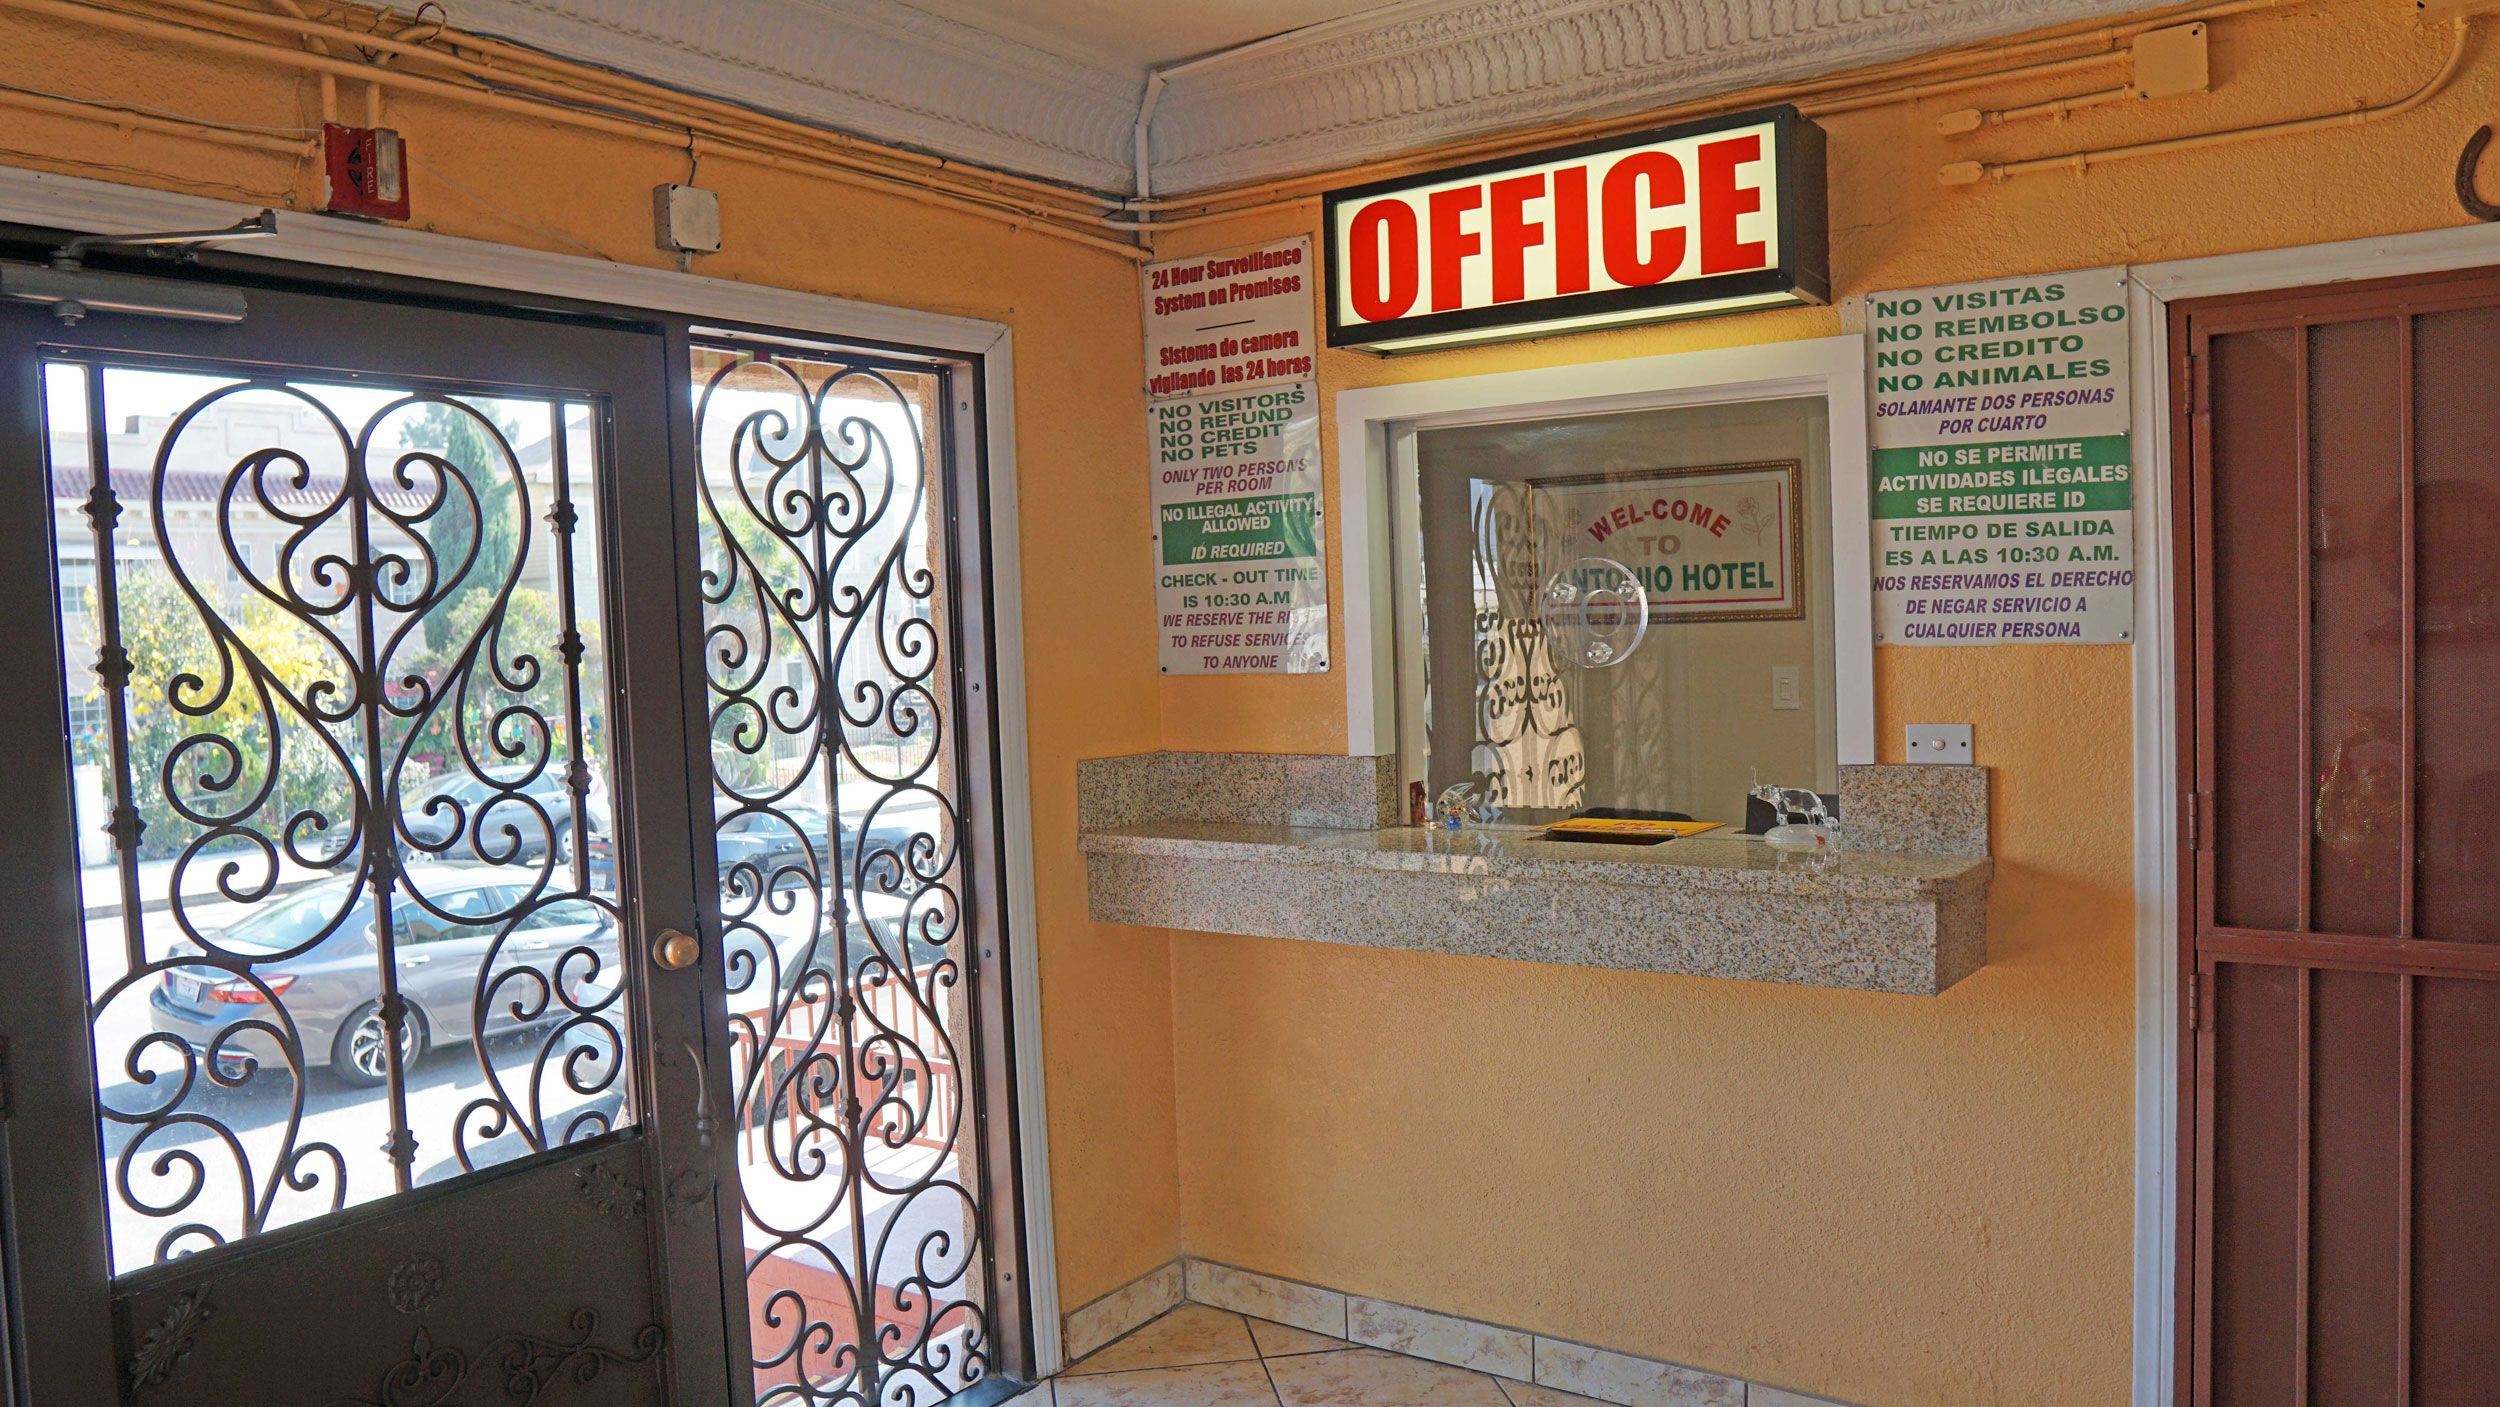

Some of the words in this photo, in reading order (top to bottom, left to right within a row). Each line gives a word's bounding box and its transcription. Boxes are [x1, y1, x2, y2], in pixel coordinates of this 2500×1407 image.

[365, 138, 375, 194] FIRE
[1348, 133, 1766, 323] OFFICE
[1152, 270, 1168, 290] 24
[1171, 265, 1205, 286] Hour
[1207, 247, 1302, 280] Surveillance
[1154, 291, 1206, 316] System
[1208, 287, 1227, 306] on
[1877, 299, 1922, 318] NO
[1932, 284, 2065, 312] VISITAS
[1877, 324, 1922, 343] NO
[1935, 304, 2125, 338] REMBOLSO
[1160, 341, 1217, 366] Sistema
[1220, 337, 1238, 357] de
[1241, 330, 1299, 354] camera
[1877, 349, 1922, 368] NO
[1935, 335, 2084, 363] CREDITO
[1150, 367, 1216, 394] vigilando
[1221, 364, 1243, 384] las
[1246, 359, 1264, 380] 24
[1267, 355, 1312, 376] horas
[1878, 374, 1923, 393] NO
[1933, 359, 2111, 389] ANIMALES
[1159, 404, 1192, 420] NO
[1198, 390, 1306, 415] VISITORS
[1876, 396, 1977, 418] SOLAMANTE
[1981, 394, 2015, 411] DOS
[2020, 387, 2115, 408] PERSONAS
[1160, 419, 1192, 434] NO
[1200, 407, 1293, 429] REFUND
[1938, 419, 1973, 435] POR
[1977, 414, 2047, 432] CUARTO
[1160, 433, 1193, 449] NO
[1200, 423, 1284, 444] CREDIT
[1161, 448, 1194, 463] NO
[1201, 441, 1258, 459] PETS
[1919, 450, 1948, 467] NO
[1955, 448, 1981, 465] SE
[1988, 443, 2082, 463] PERMITE
[1162, 468, 1199, 484] ONLY
[1202, 465, 1233, 481] TWO
[1238, 458, 1307, 477] PERSONS
[1878, 470, 2015, 492] ACTIVIDADES
[2022, 464, 2129, 486] ILEGALES
[1196, 481, 1223, 495] PER
[1227, 476, 1273, 492] ROOM
[1162, 507, 1183, 522] NO
[1187, 503, 1242, 520] ILLEGAL
[1246, 496, 1313, 515] ACTIVITY
[1917, 497, 1942, 513] SE
[1950, 492, 2057, 512] REQUIERE
[2063, 491, 2085, 508] ID
[1202, 516, 1271, 534] ALLOWED
[1587, 498, 1732, 543] WEL-COME
[1890, 523, 1979, 542] TIEMPO
[1987, 522, 2018, 539] DE
[2025, 519, 2115, 537] SALIDA
[1191, 545, 1206, 560] ID
[1210, 541, 1285, 559] REQUIRED
[1636, 534, 1681, 556] TO
[1886, 550, 1913, 566] ES
[1921, 550, 1937, 565] A
[1942, 548, 1988, 564] LAS
[1997, 546, 2059, 563] 10:30
[2068, 545, 2119, 562] A.M.
[1161, 573, 1217, 588] CHECK
[1233, 570, 1269, 584] OUT
[1274, 566, 1318, 582] TIME
[1682, 561, 1774, 591] HOTEL
[1873, 575, 1906, 592] NOS
[1910, 572, 2020, 590] RESERVAMOS
[2025, 572, 2045, 588] EL
[2051, 570, 2134, 587] DERECHO
[1183, 595, 1198, 608] IS
[1205, 592, 1250, 607] 10:30
[1906, 599, 1926, 614] DE
[1931, 598, 1987, 614] NEGAR
[1992, 597, 2071, 614] SERVICIO
[2075, 596, 2087, 612] A
[1163, 614, 1183, 627] WE
[1186, 611, 1244, 626] RESERVE
[1248, 611, 1274, 625] THE
[1904, 622, 1996, 639] CUALQUIER
[2001, 621, 2081, 638] PERSONA
[1172, 635, 1187, 648] TO
[1191, 634, 1241, 648] REFUSE
[1203, 656, 1219, 668] TO
[1223, 655, 1278, 668] ANYONE
